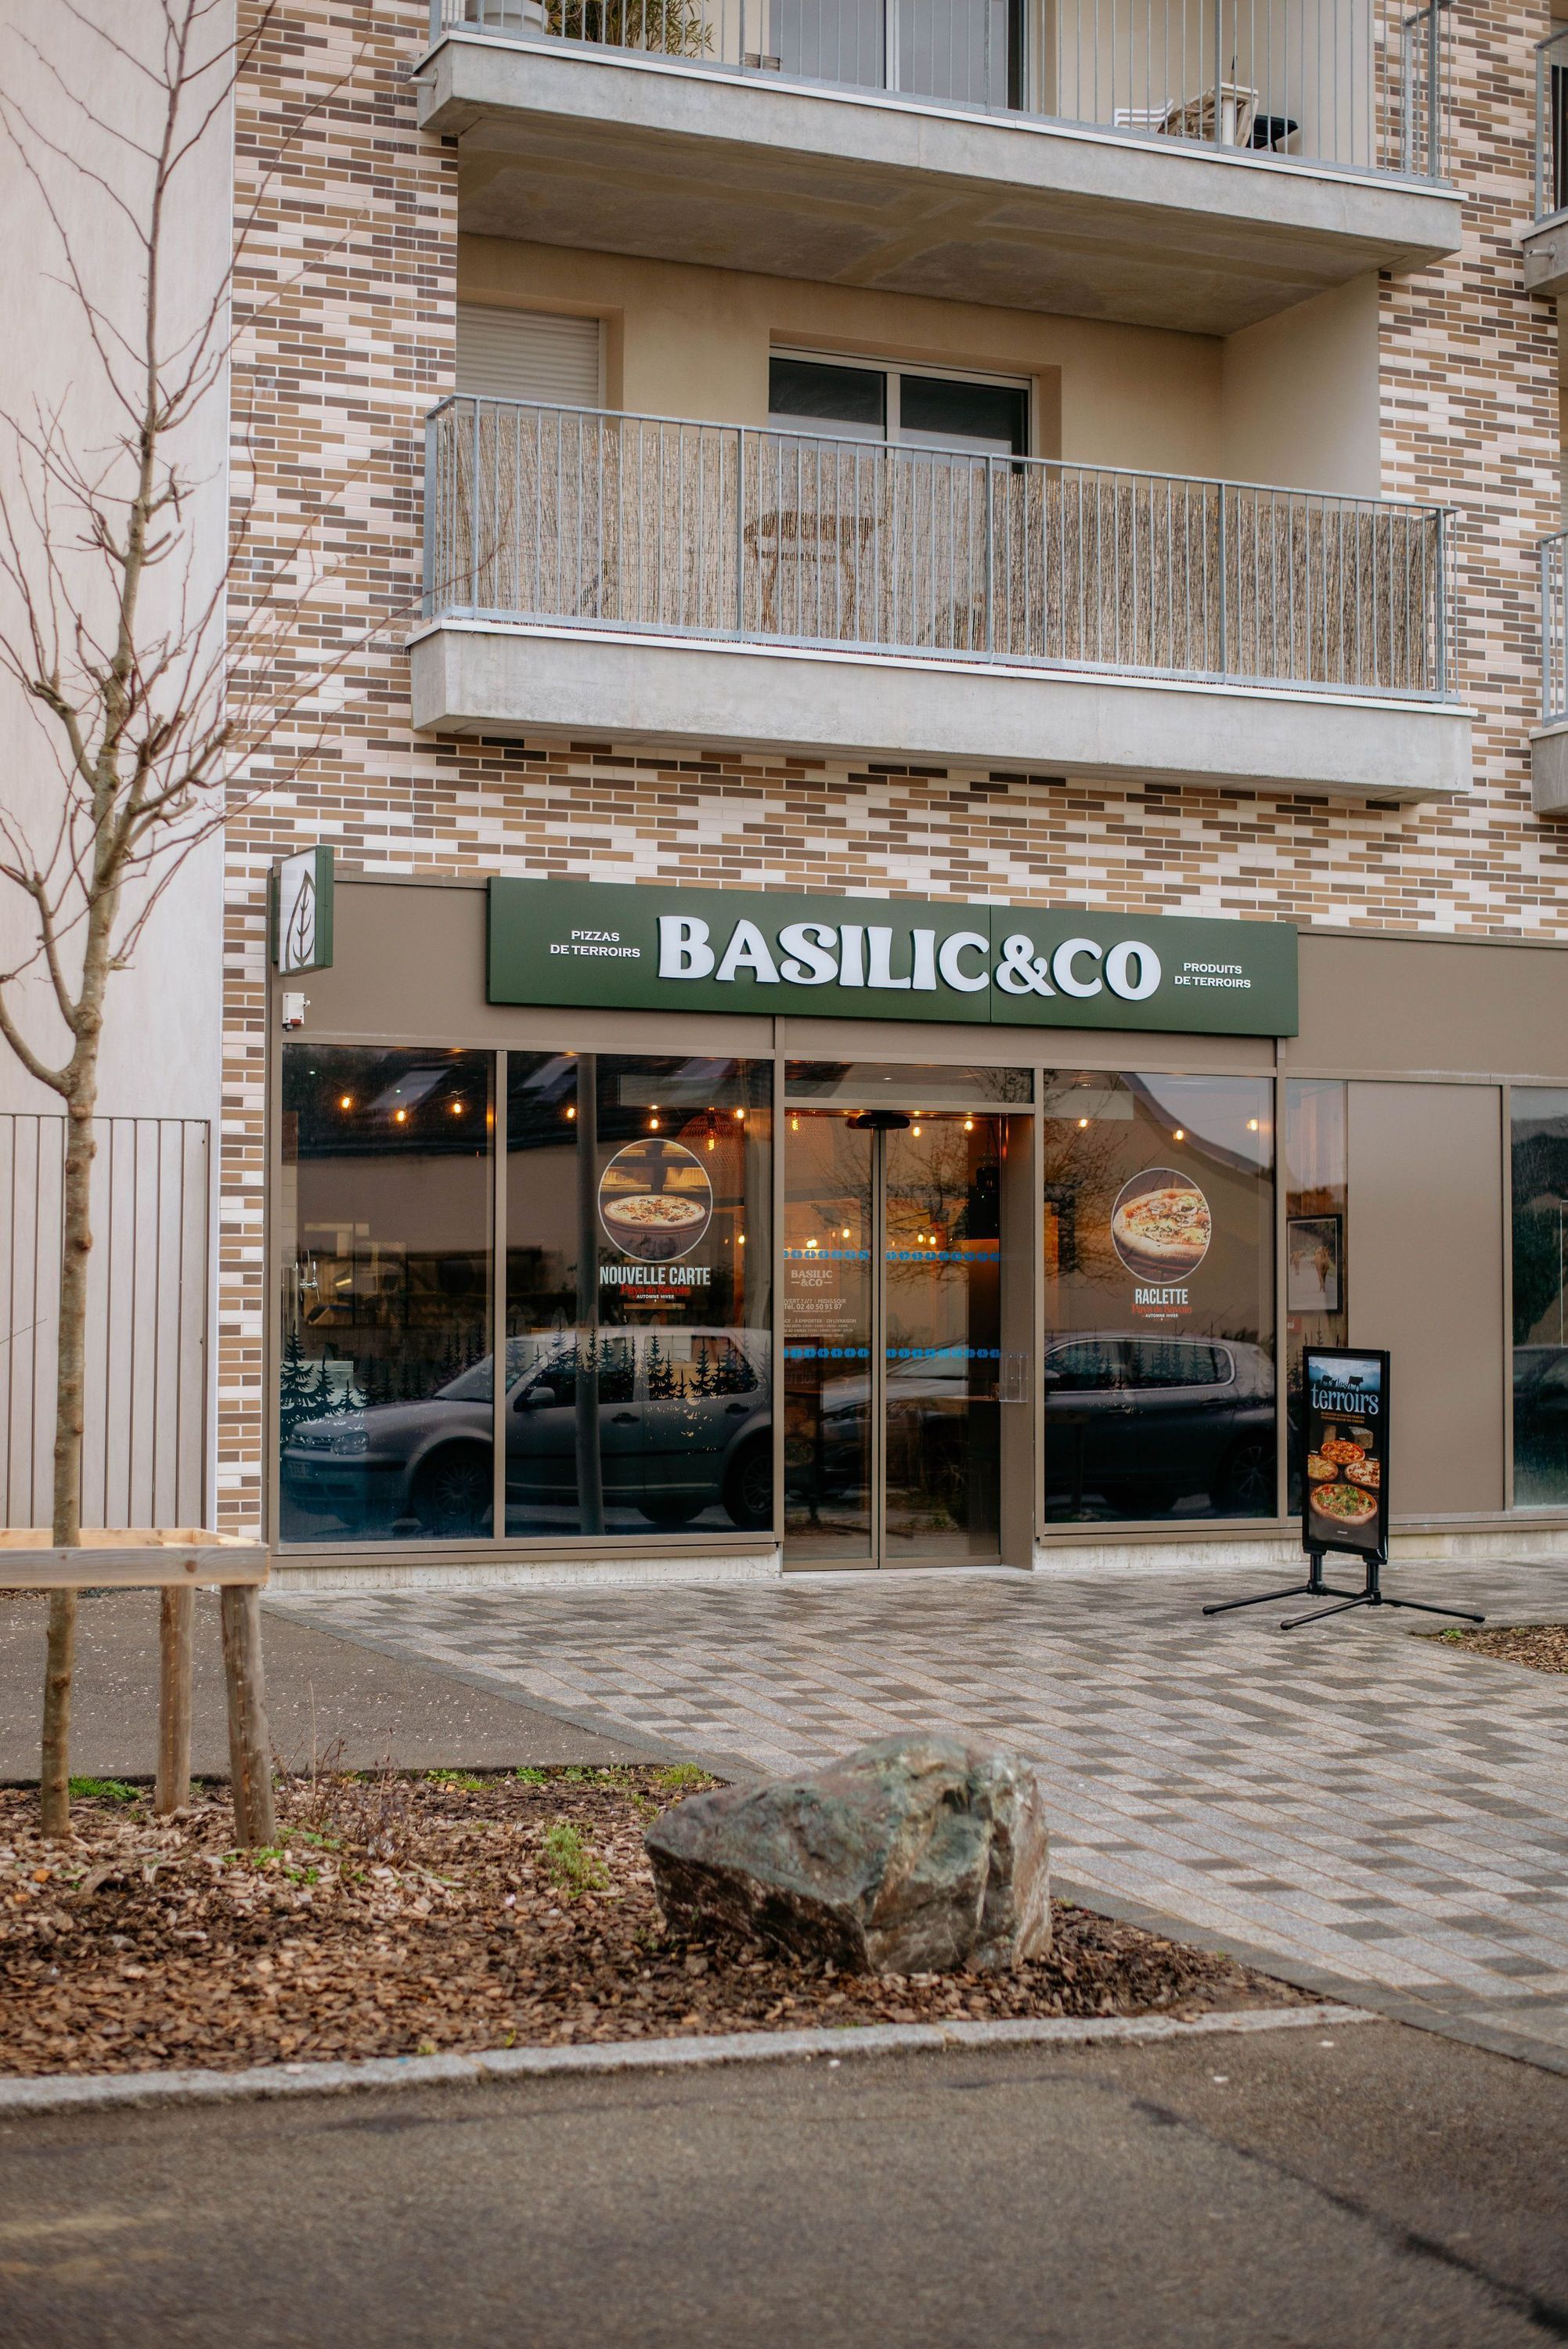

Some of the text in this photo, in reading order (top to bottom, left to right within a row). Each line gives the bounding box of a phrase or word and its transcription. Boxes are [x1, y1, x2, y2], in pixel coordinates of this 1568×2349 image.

[571, 930, 620, 942] PIZZAS
[550, 944, 641, 958] DE TERROIRS
[657, 915, 1162, 1001] BASILIC&CO
[1183, 962, 1242, 974] PRODUITS
[1174, 976, 1251, 988] DE TERROIRS
[600, 1266, 711, 1285] NOUVELLE CARTE
[791, 1269, 833, 1278] BASILIC
[1135, 1288, 1188, 1304] RACLETTE
[1311, 1383, 1379, 1415] terroirs
